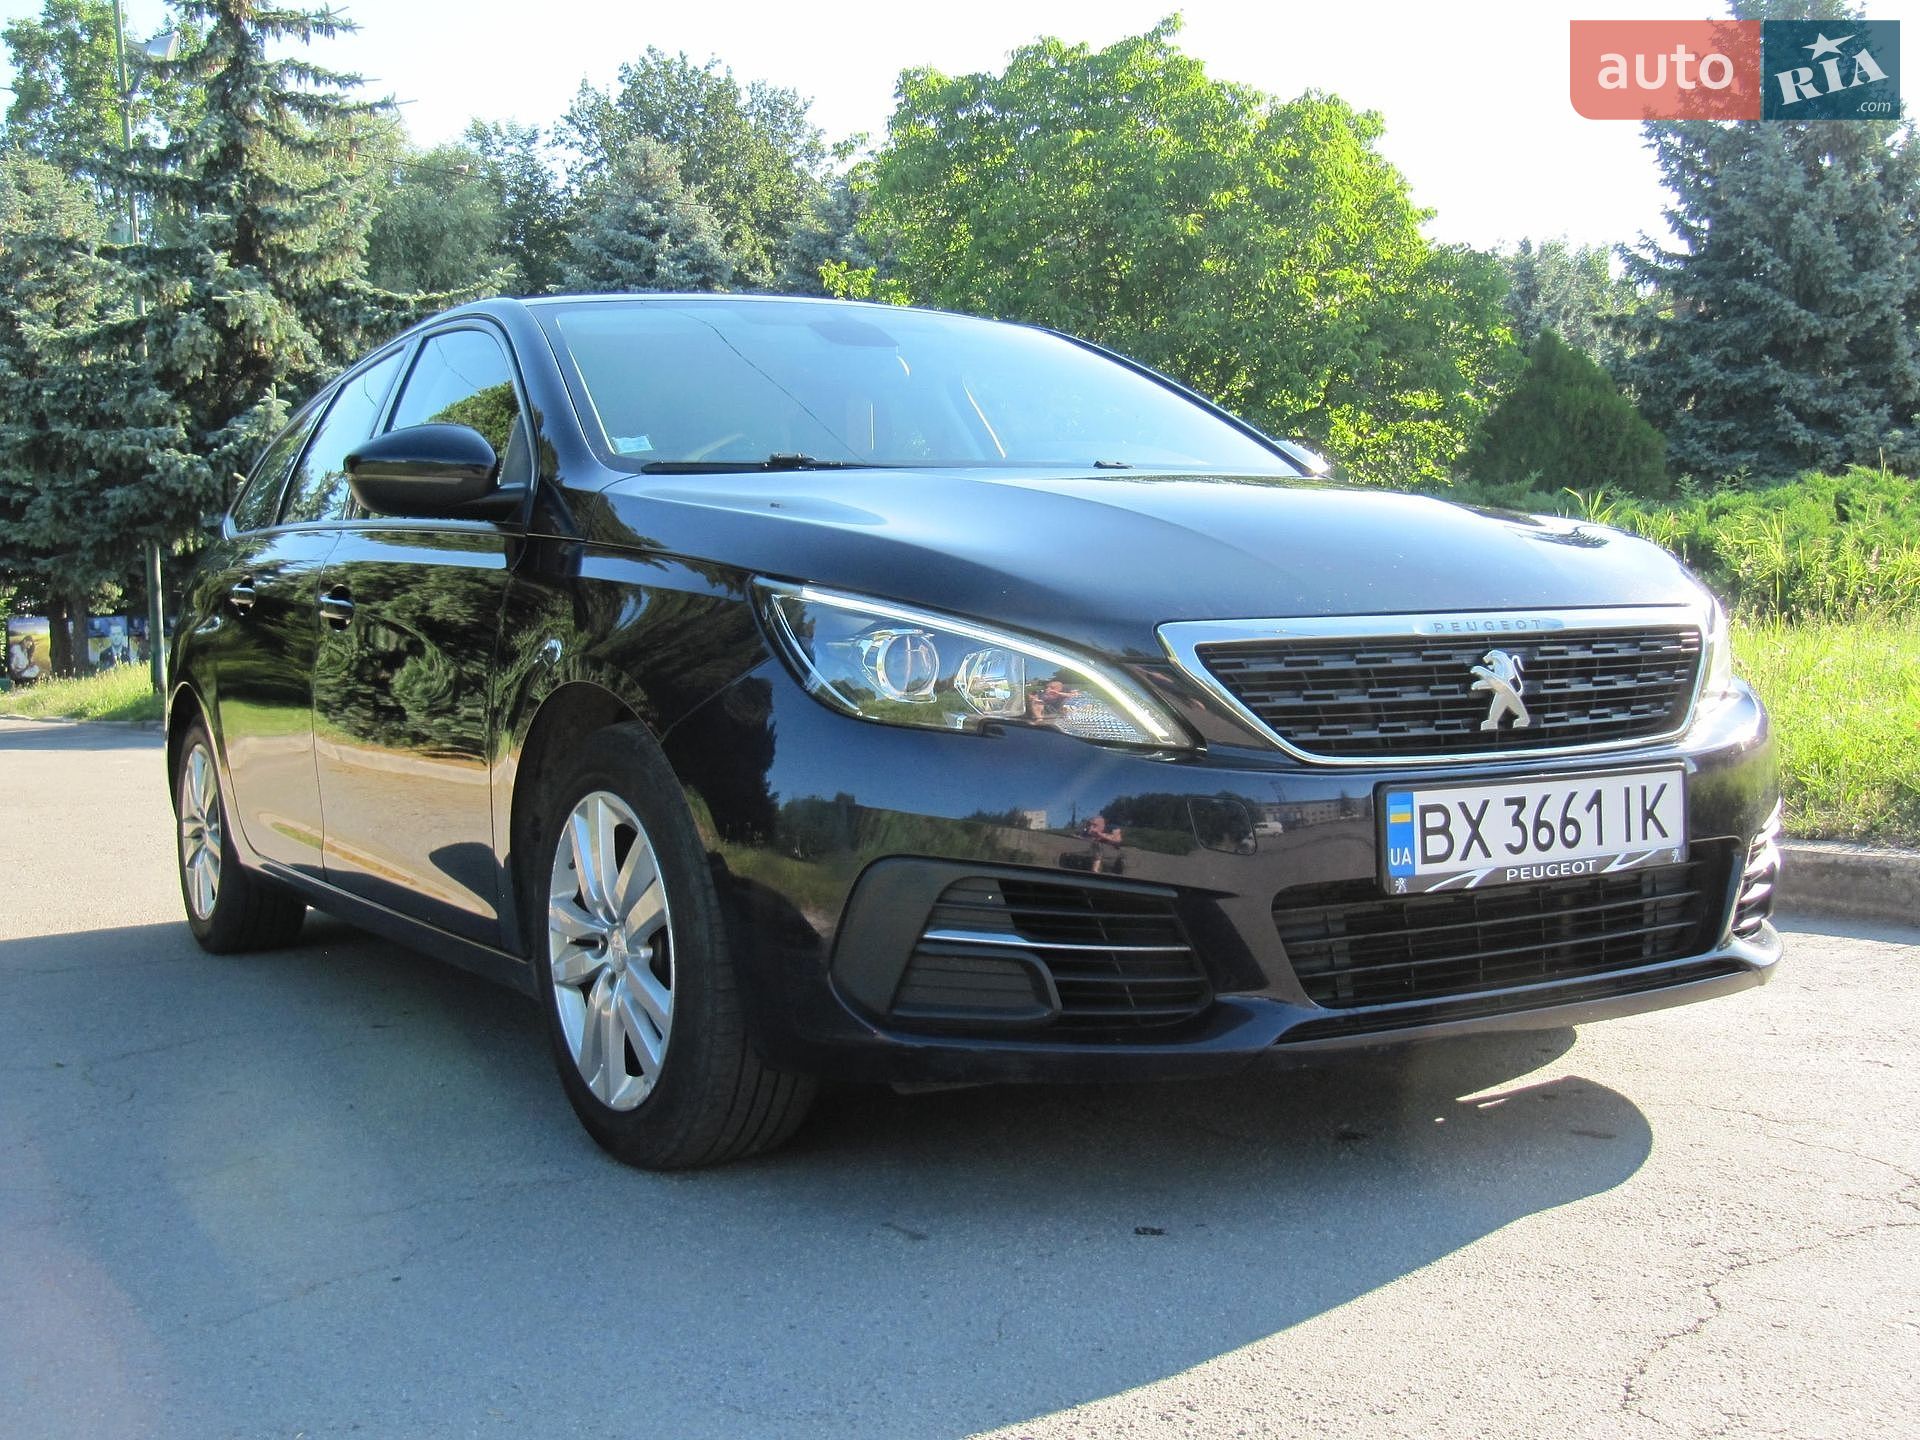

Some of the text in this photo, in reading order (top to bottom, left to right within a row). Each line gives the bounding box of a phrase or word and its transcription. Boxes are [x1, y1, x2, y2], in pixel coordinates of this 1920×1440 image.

[1433, 619, 1541, 633] PEUGEOT
[1418, 782, 1669, 865] BX 3661 IK
[1389, 847, 1412, 866] UA
[1506, 859, 1597, 882] PEUGEOT
